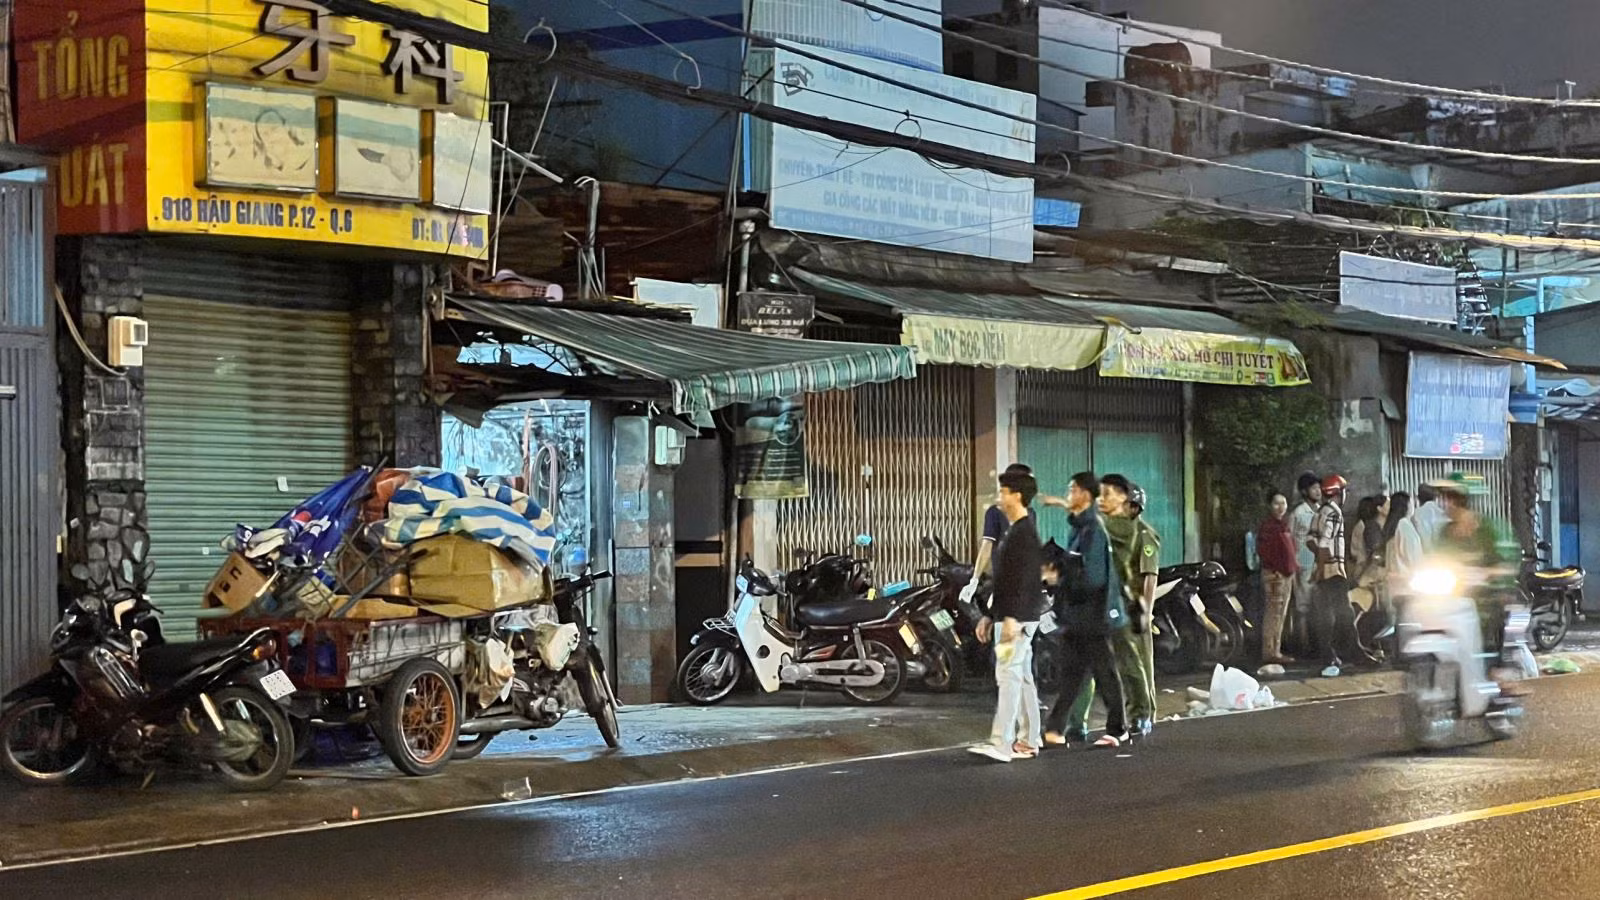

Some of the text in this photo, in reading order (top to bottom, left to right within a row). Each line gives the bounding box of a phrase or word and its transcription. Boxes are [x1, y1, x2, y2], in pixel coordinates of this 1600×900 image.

[58, 133, 129, 207] UÁT
[161, 196, 193, 222] 918
[196, 194, 232, 228] HẬU
[235, 200, 285, 228] GIANG
[329, 208, 353, 235] Q.6
